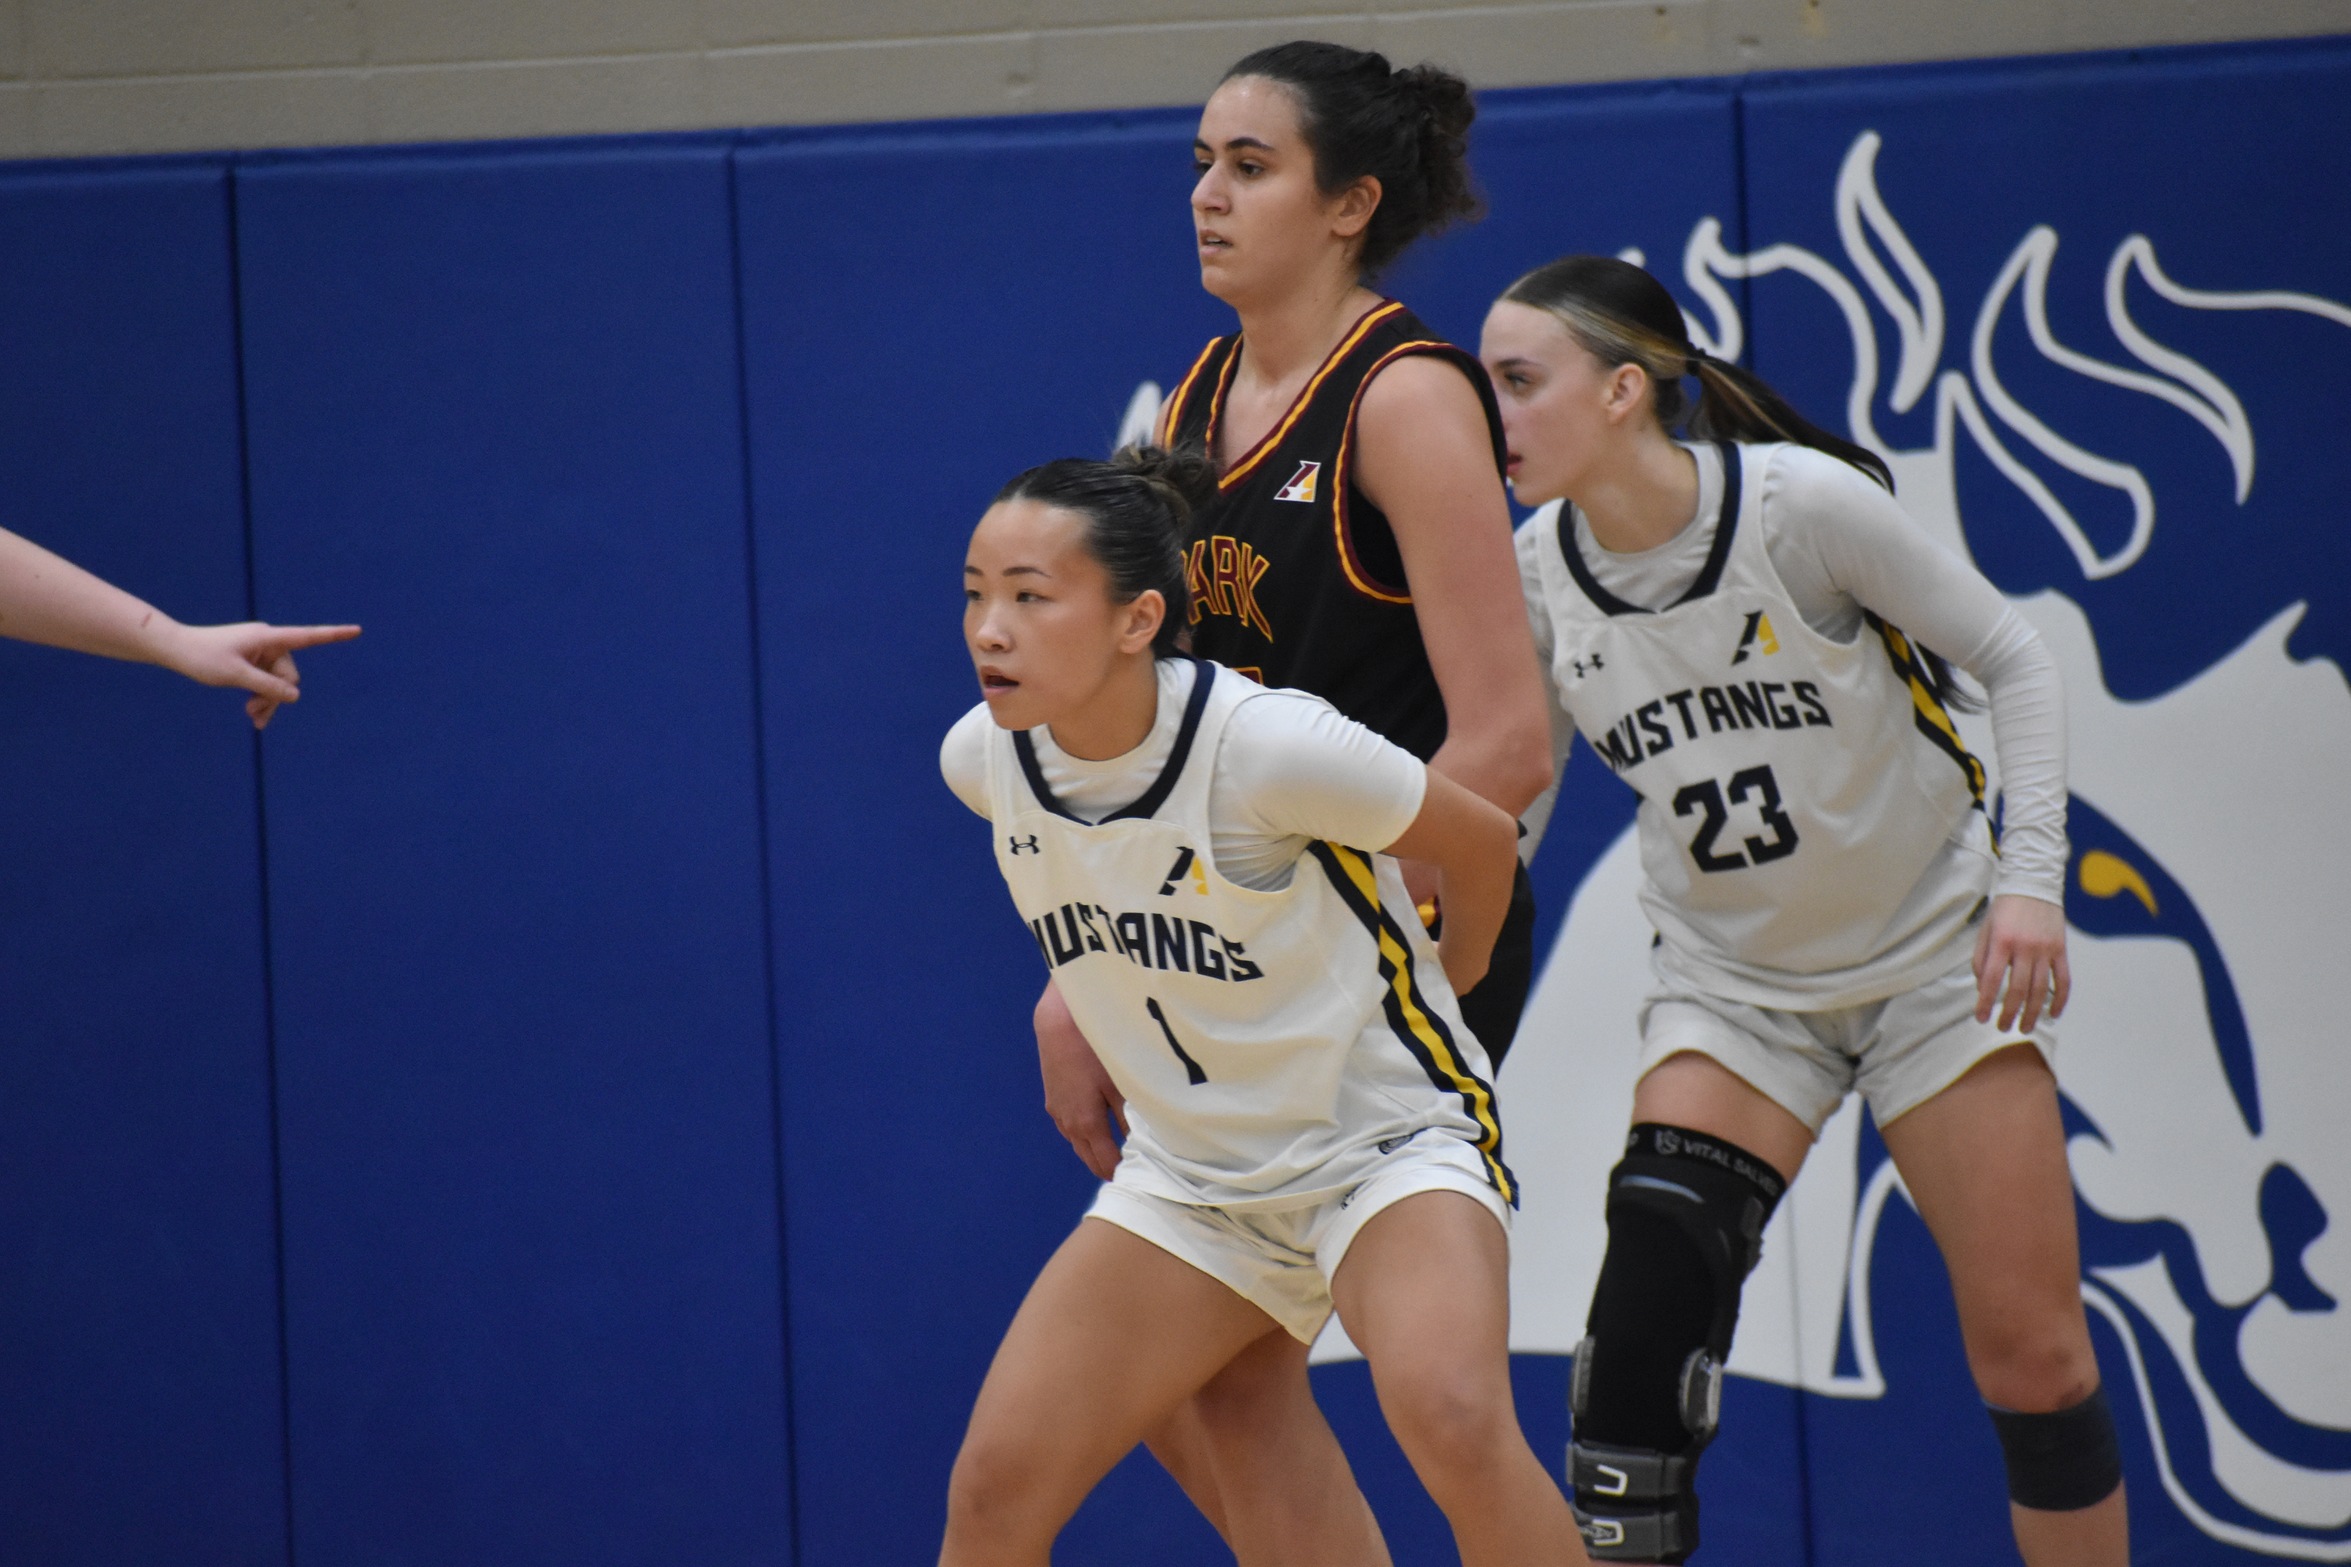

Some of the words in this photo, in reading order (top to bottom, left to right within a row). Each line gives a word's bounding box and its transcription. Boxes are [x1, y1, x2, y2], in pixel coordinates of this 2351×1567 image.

[1180, 535, 1274, 644] ARK
[1672, 764, 1799, 873] 23
[1146, 996, 1208, 1086] 1
[1683, 1138, 1732, 1168] VITAL
